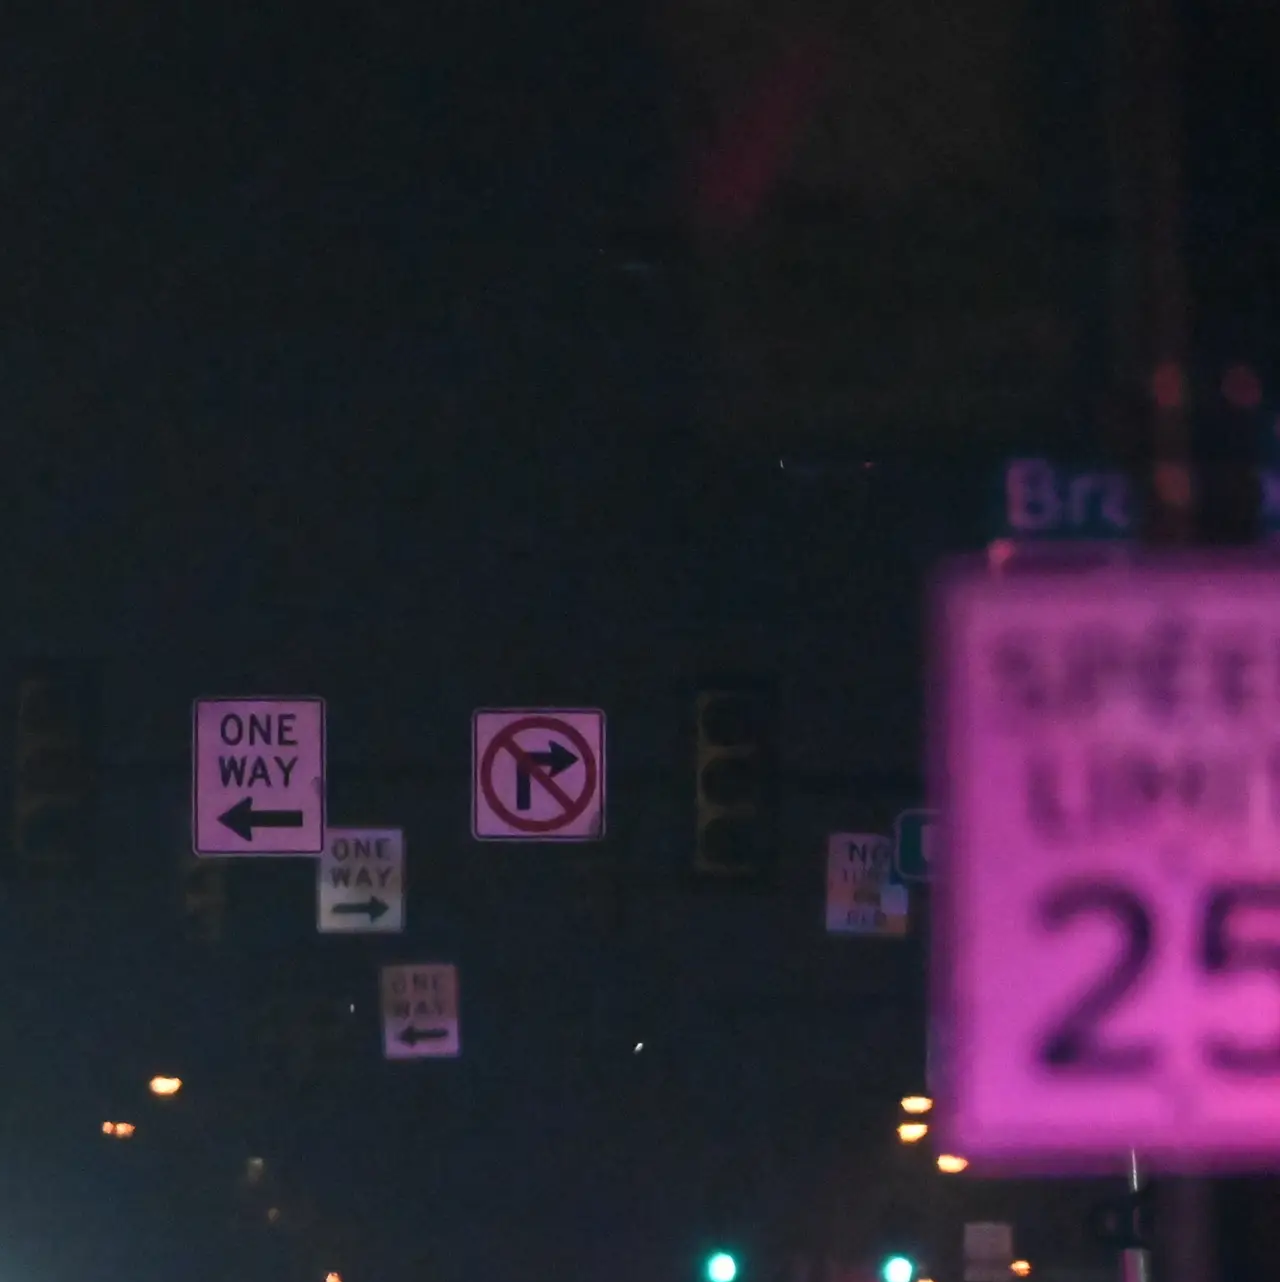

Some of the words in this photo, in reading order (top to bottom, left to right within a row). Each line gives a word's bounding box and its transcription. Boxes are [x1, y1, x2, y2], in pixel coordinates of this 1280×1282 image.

[220, 713, 298, 746] ONE
[218, 756, 298, 788] WAY
[331, 837, 390, 861] ONE
[329, 866, 394, 889] WAY
[1037, 873, 1280, 1075] 25
